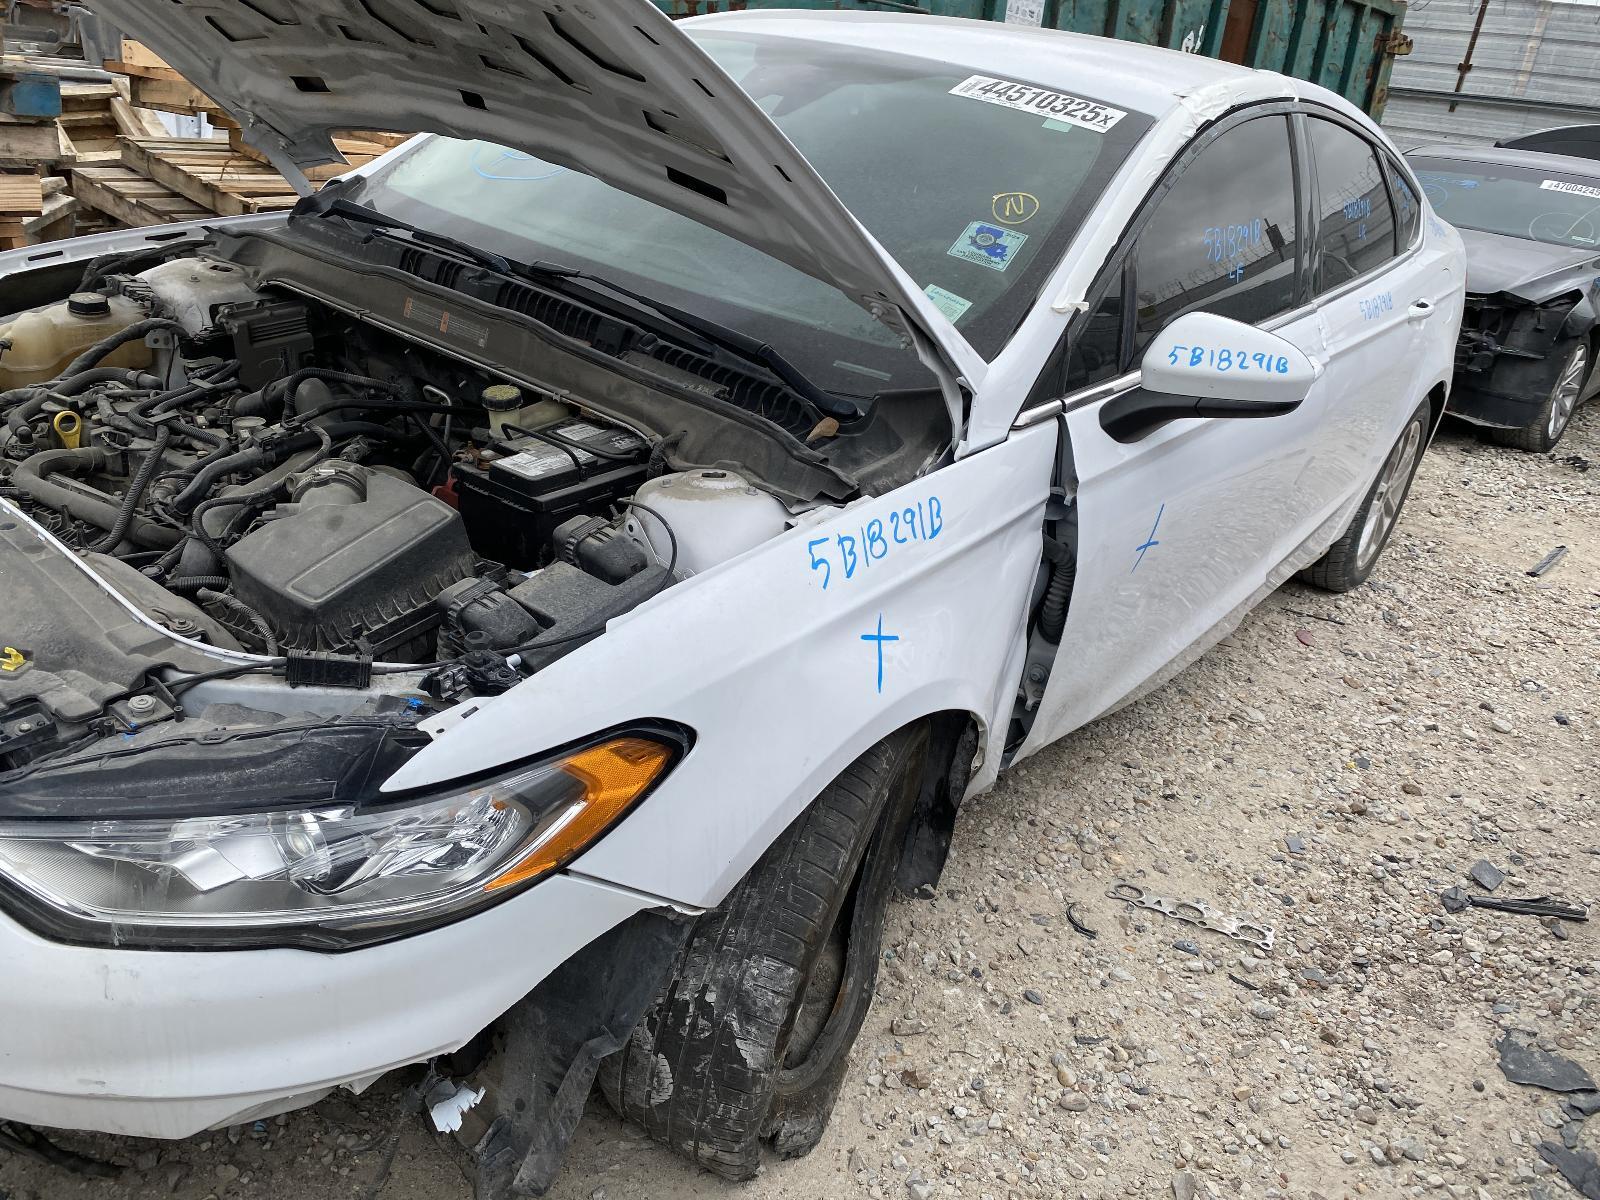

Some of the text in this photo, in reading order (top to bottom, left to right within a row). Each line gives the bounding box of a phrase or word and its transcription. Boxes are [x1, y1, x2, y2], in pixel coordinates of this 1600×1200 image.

[1005, 194, 1024, 217] N
[1168, 345, 1289, 374] 5B18291B
[808, 496, 943, 590] 5B18291B
